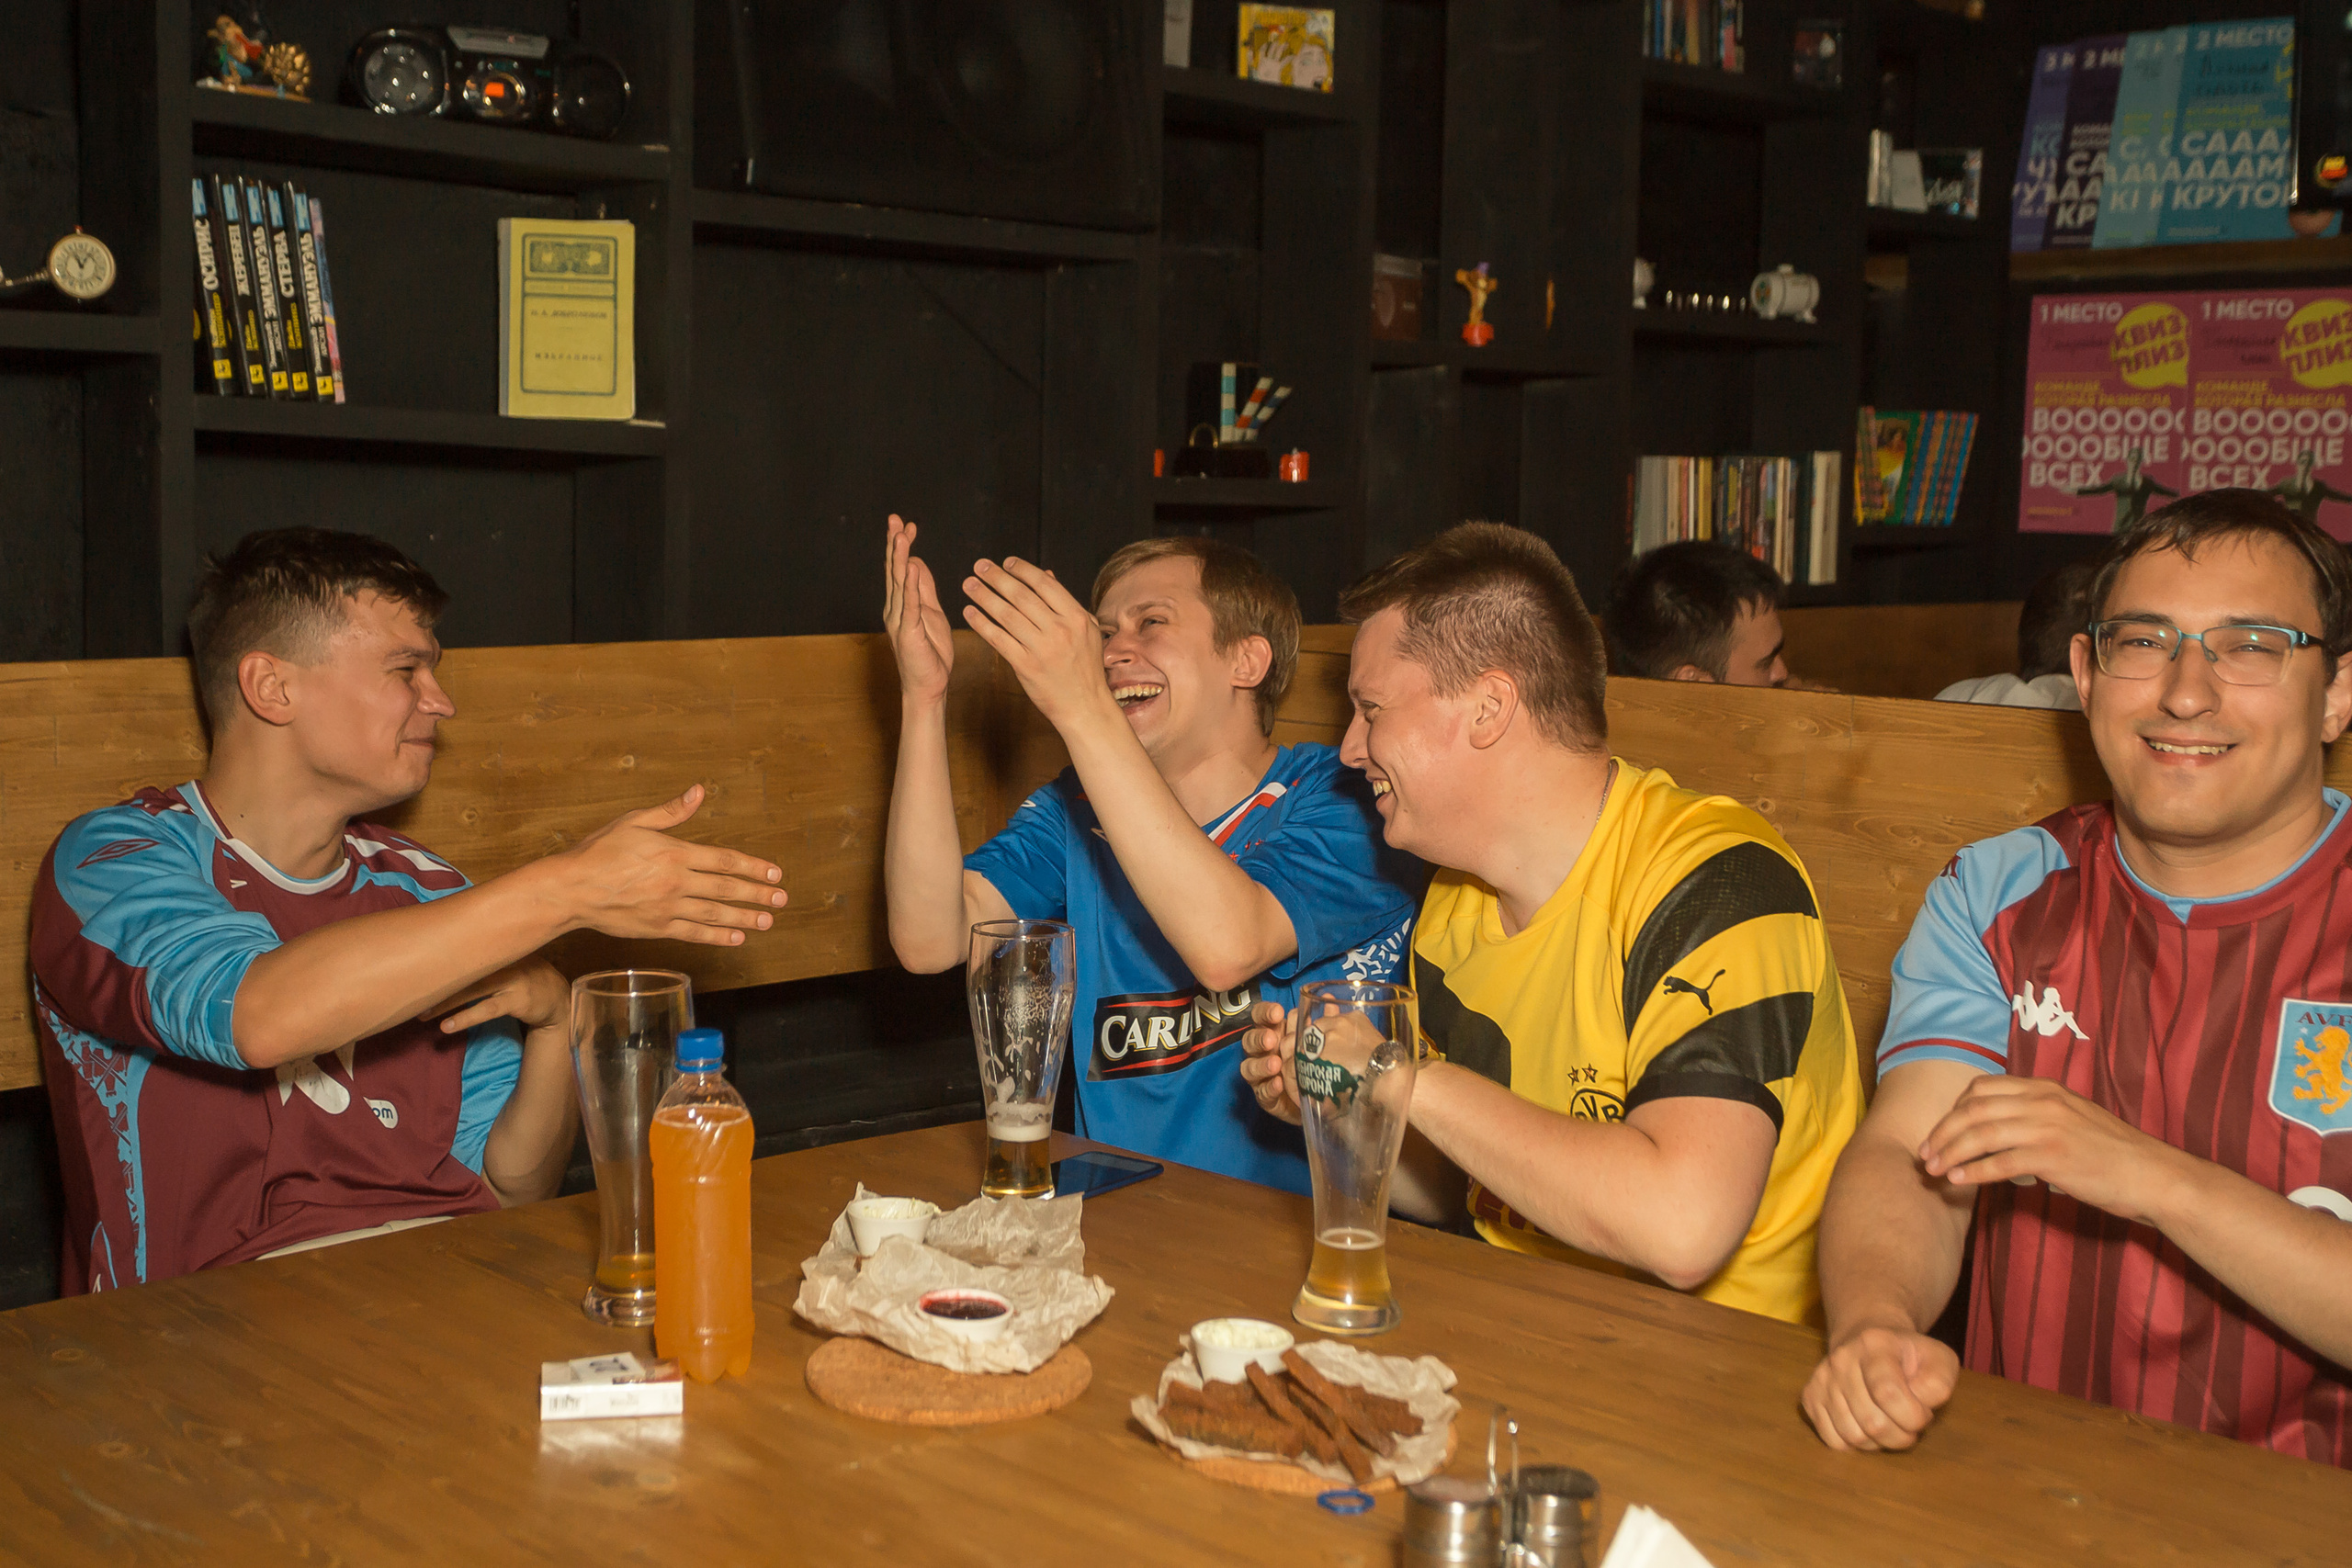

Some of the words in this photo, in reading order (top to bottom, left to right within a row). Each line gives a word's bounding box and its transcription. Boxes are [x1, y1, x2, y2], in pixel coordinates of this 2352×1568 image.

[2180, 129, 2290, 157] СААА
[194, 218, 220, 291] ОСИРИС
[228, 223, 251, 297] ЖЕРЕБЕЦ
[273, 230, 295, 299] СТЕРВА
[253, 225, 277, 321] ЭММАНУЭЛЬ
[300, 231, 323, 327] ЭММАНУЭЛЬ
[2039, 304, 2047, 324] 1
[2052, 301, 2123, 324] МЕСТО
[2202, 299, 2211, 320] 1
[2216, 298, 2295, 321] МЕСТО
[2114, 310, 2186, 351] КВИЗ
[2119, 340, 2187, 375] ПЛИЗ
[2192, 406, 2352, 436] ВООООО
[2182, 435, 2345, 467] ОООБЩЕ
[2029, 461, 2104, 487] ВСЕХ
[2188, 464, 2272, 491] ВСЕХ
[1101, 988, 1252, 1062] CARLNG
